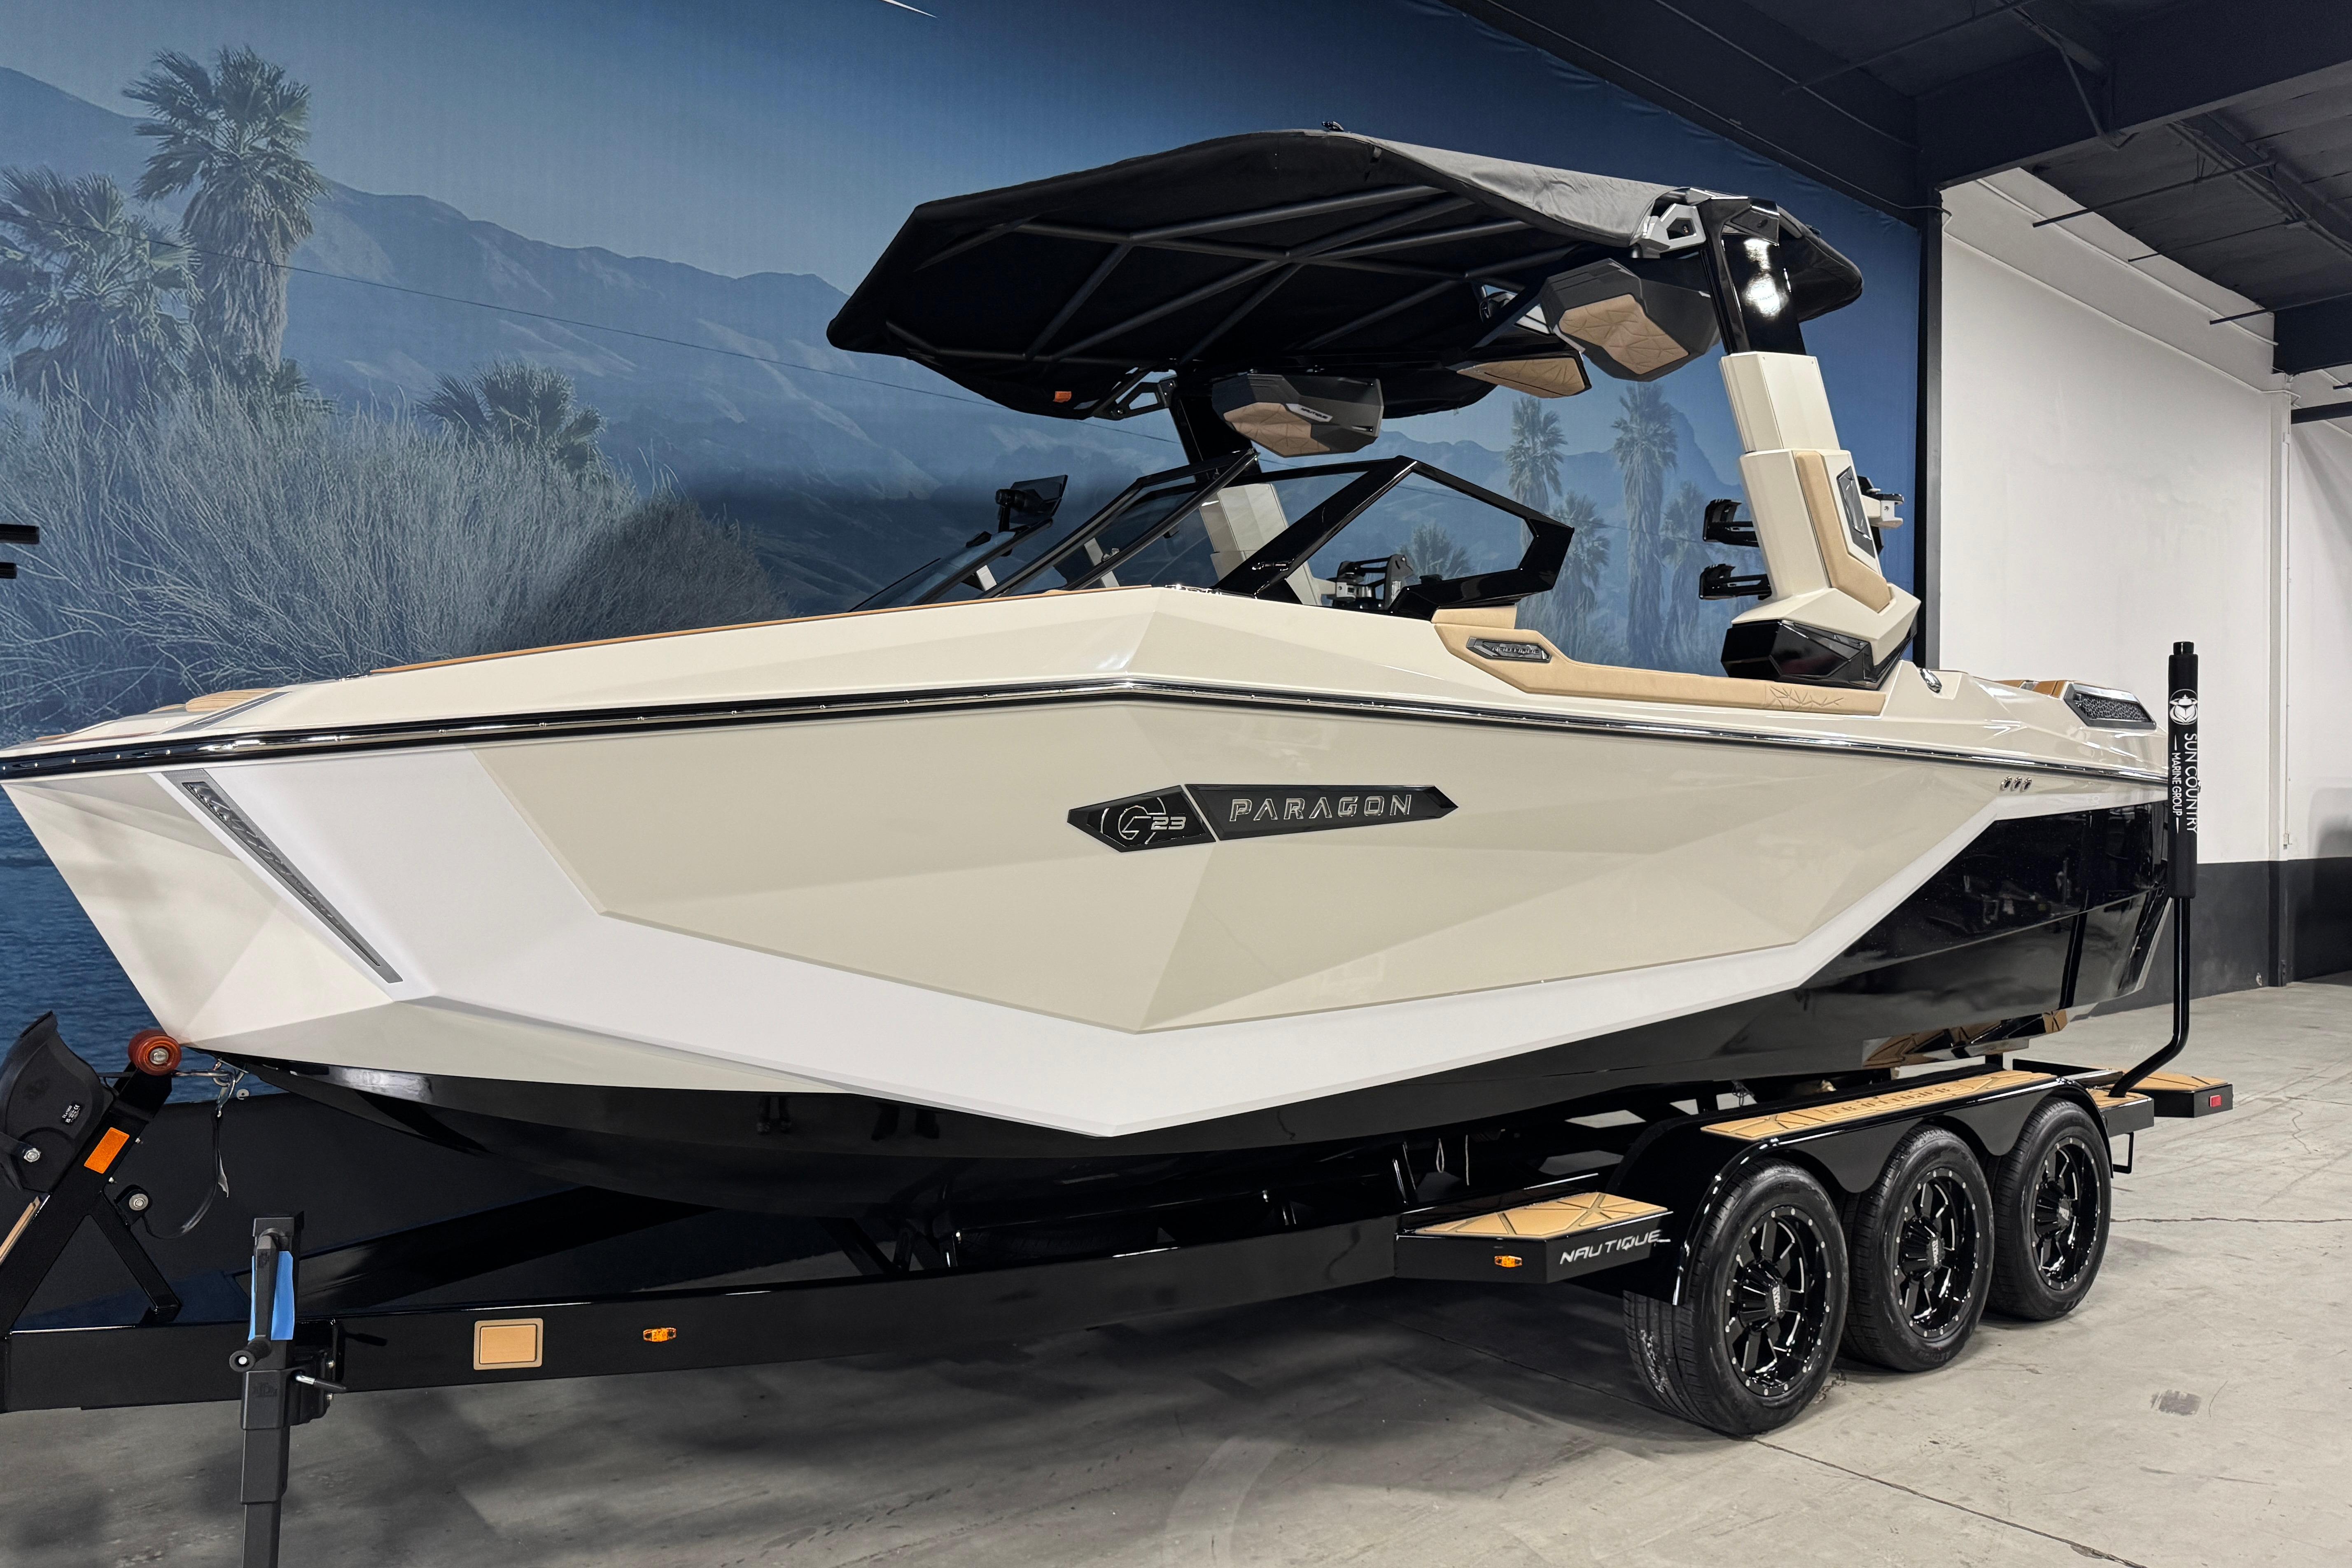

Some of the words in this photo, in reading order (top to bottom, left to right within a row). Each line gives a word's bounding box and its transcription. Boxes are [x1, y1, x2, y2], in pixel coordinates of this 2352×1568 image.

[2184, 733, 2198, 762] SUN
[2172, 752, 2182, 784] MARINE
[1229, 794, 1412, 822] PARAGON
[2172, 786, 2182, 816] GROUP
[2185, 766, 2198, 834] COUNTRY
[1559, 1229, 1662, 1265] NAUTIQUE
